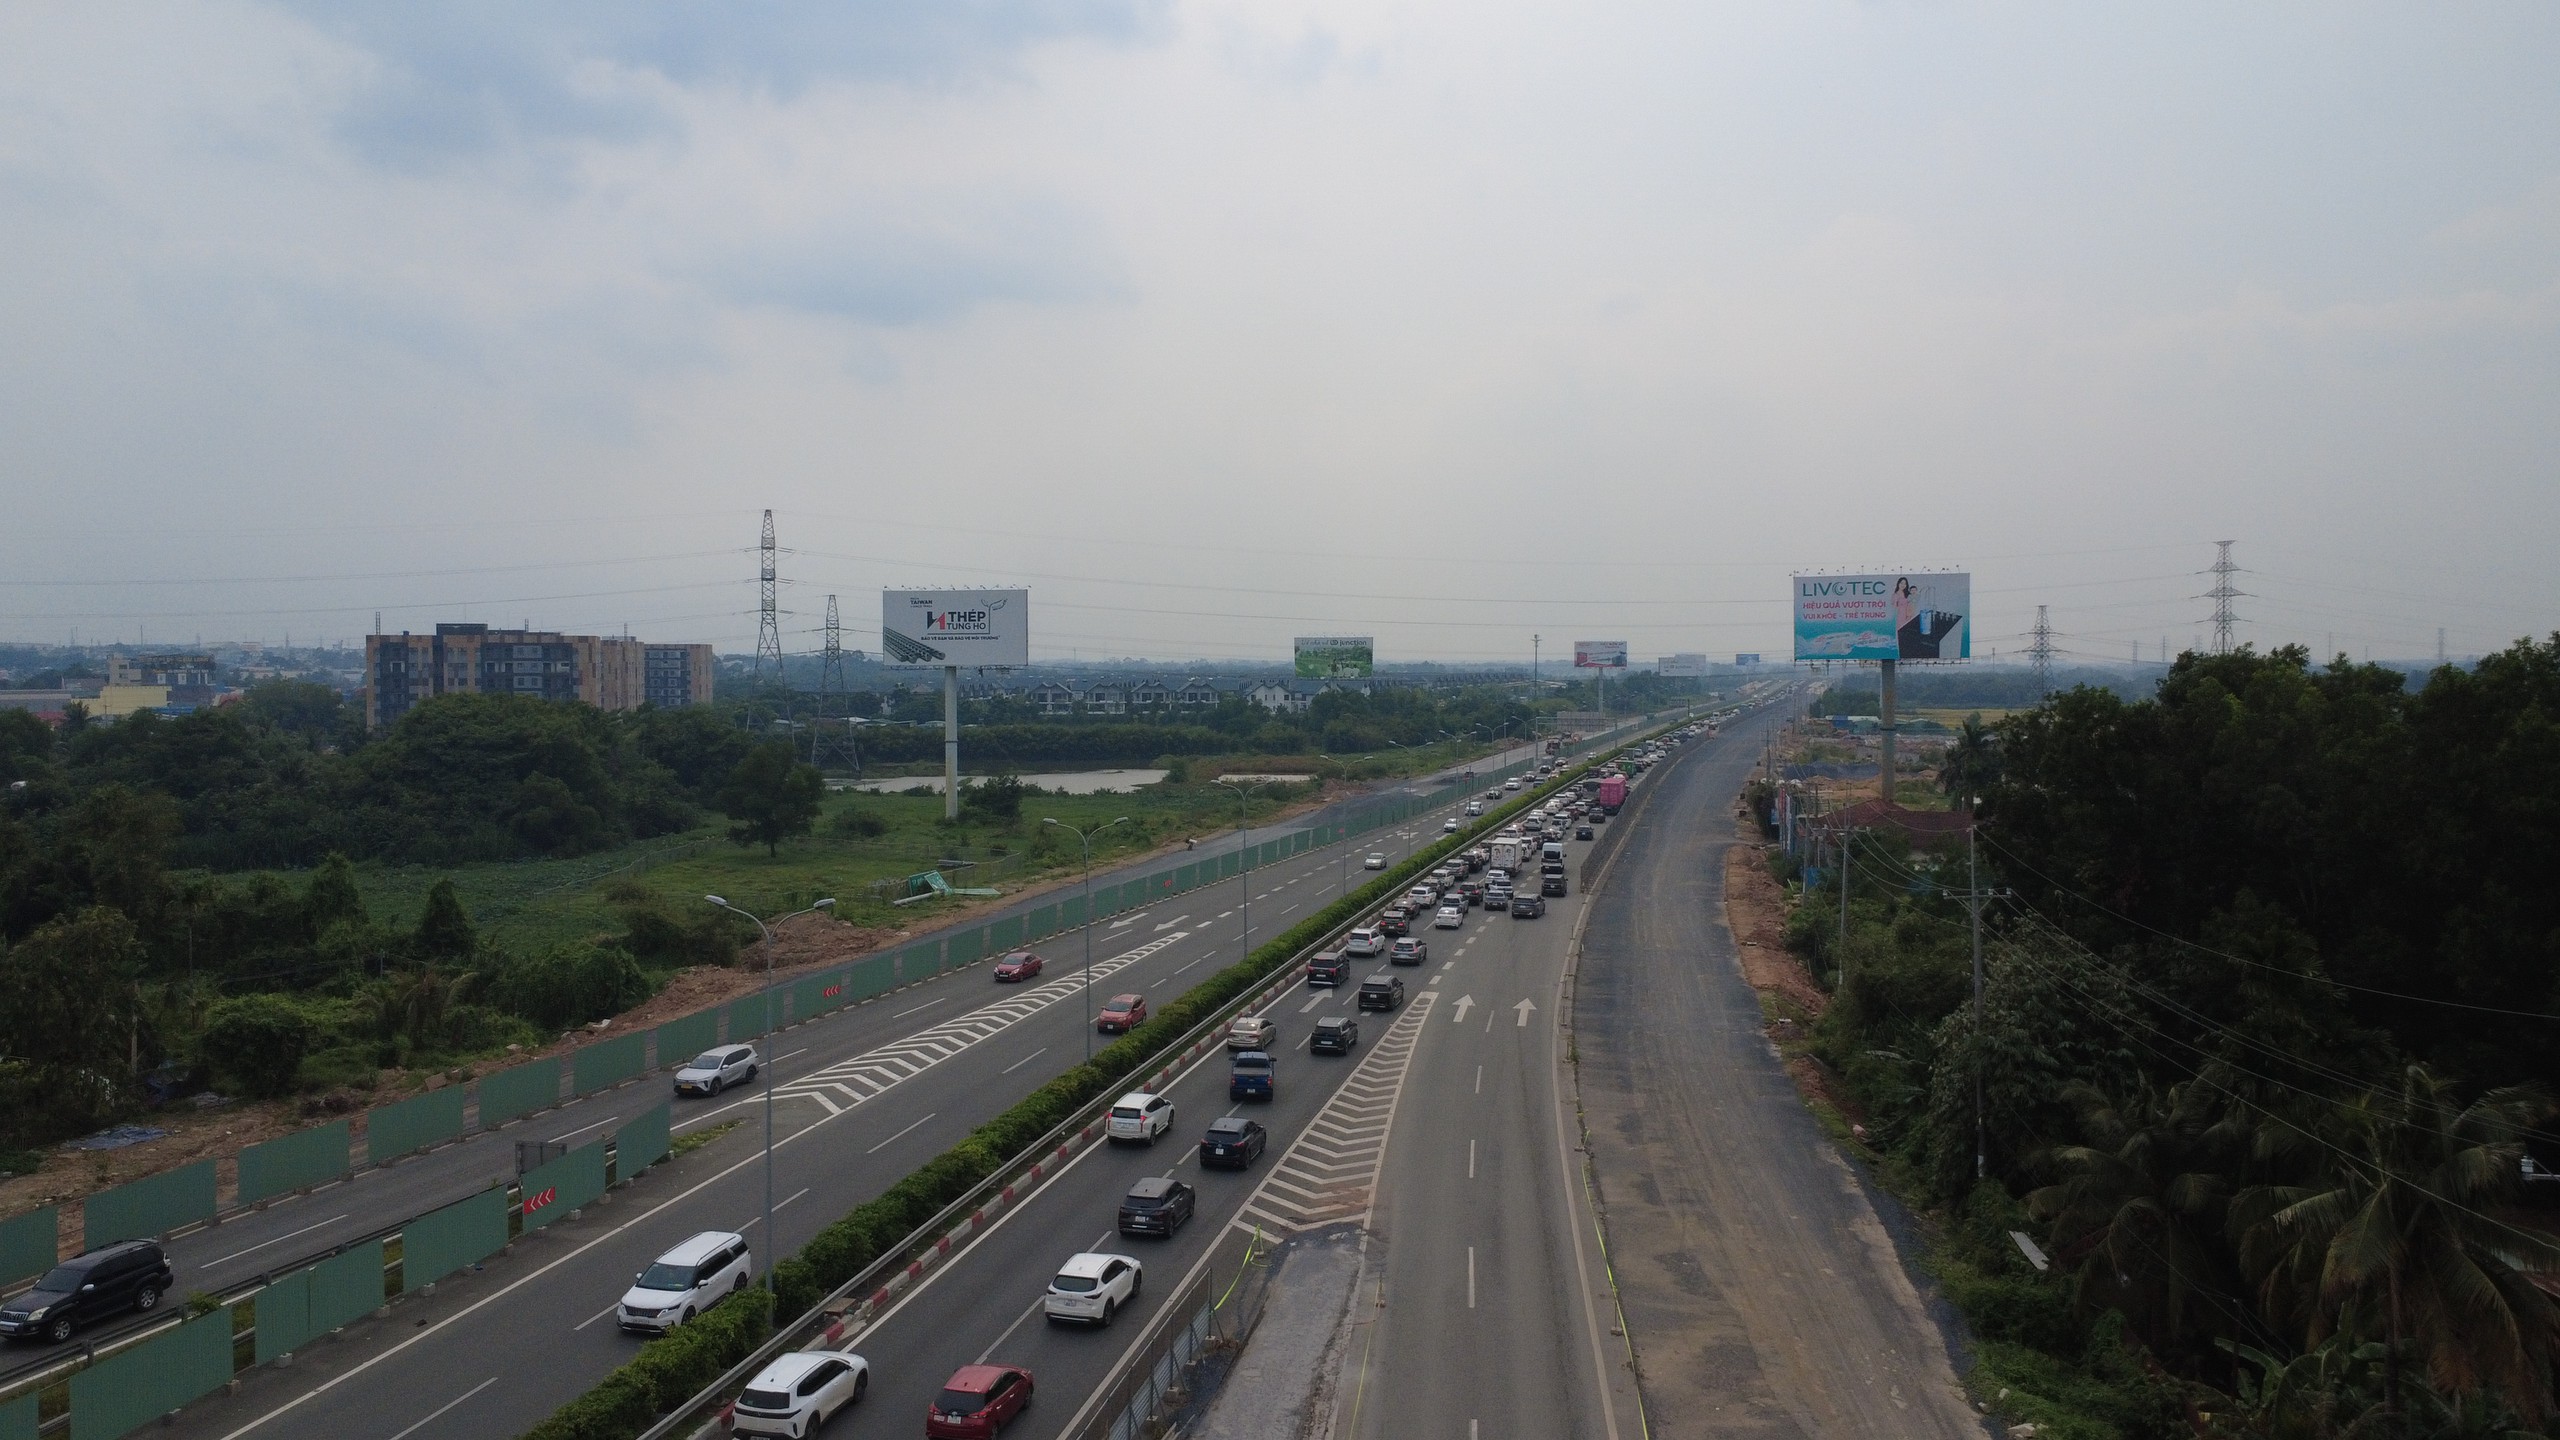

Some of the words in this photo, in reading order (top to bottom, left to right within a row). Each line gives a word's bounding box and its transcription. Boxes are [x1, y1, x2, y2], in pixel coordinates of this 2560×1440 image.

[1803, 581, 1886, 596] LIVOTEC
[1803, 601, 1821, 610] HIỆU
[1823, 600, 1841, 609] QUẢ
[1842, 600, 1865, 609] VƯỢT
[948, 609, 986, 622] THÉP
